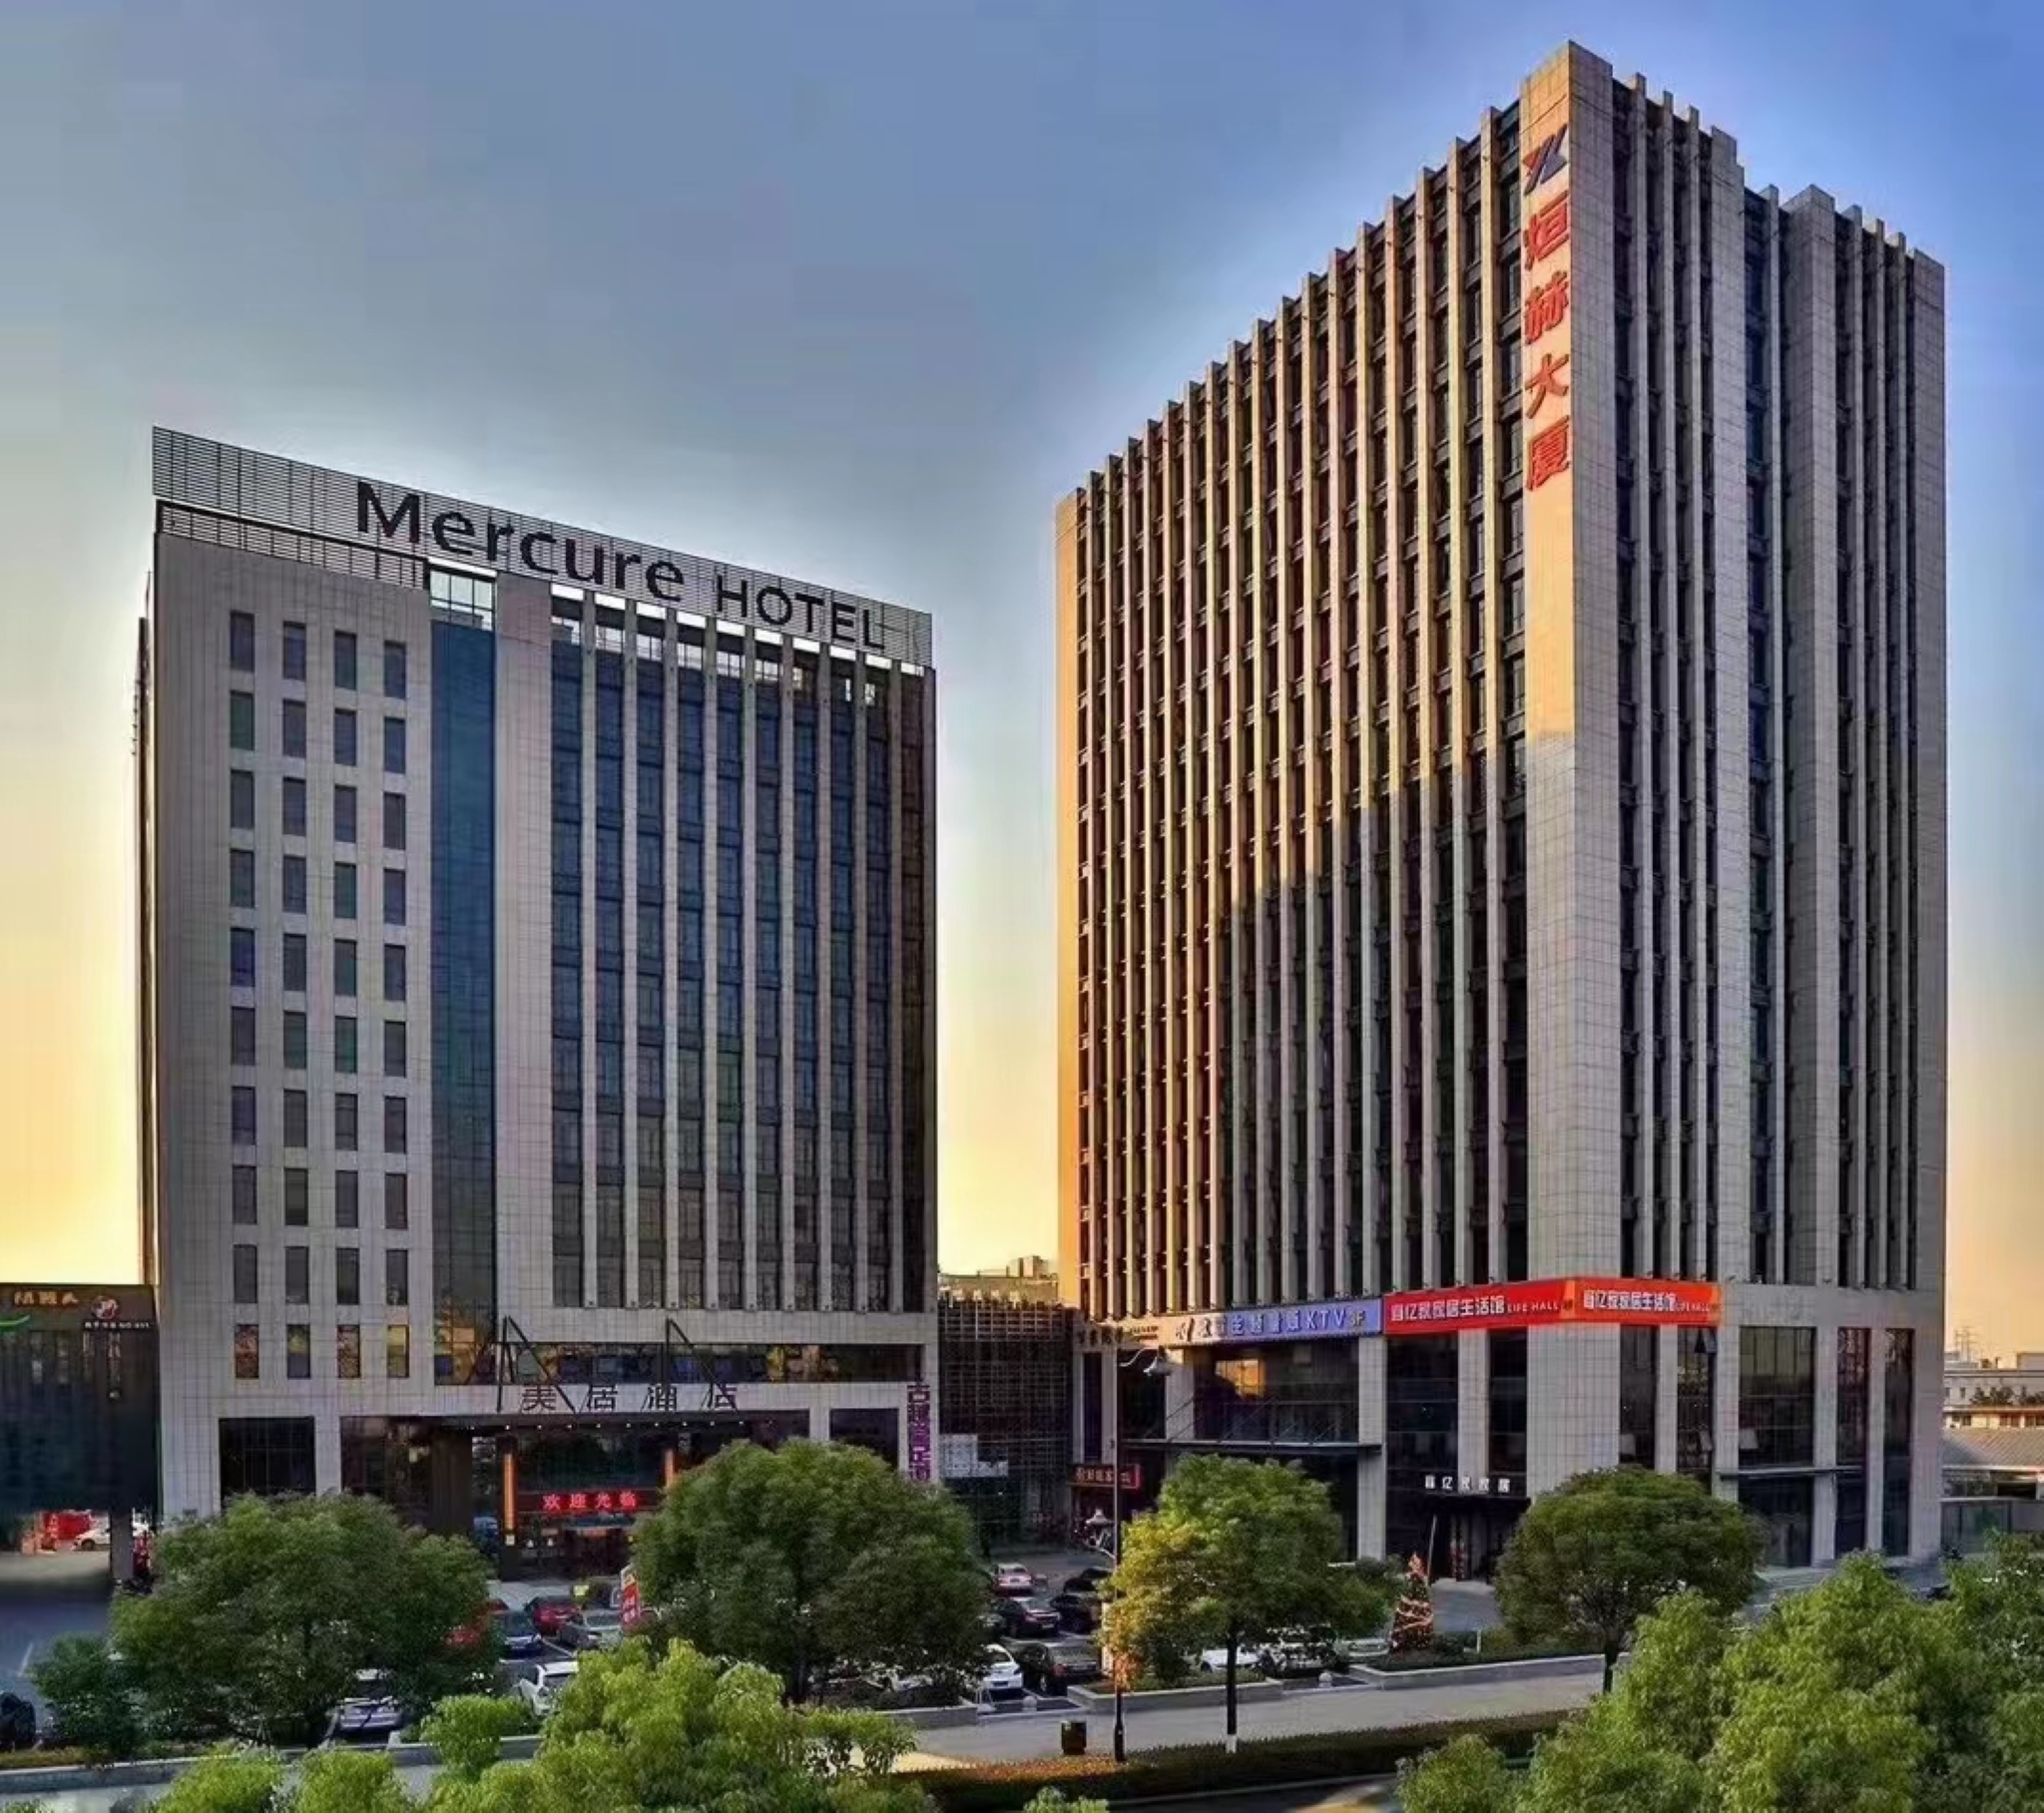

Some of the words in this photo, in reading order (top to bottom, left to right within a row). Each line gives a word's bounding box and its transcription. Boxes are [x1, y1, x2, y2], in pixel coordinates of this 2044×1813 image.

[357, 481, 685, 602] Mercure
[716, 574, 885, 649] HOTEL
[1532, 1300, 1558, 1311] HALL
[1305, 1308, 1346, 1330] KTV
[521, 1383, 739, 1412] 美居酒店
[542, 1491, 639, 1511] 欢迎光临
